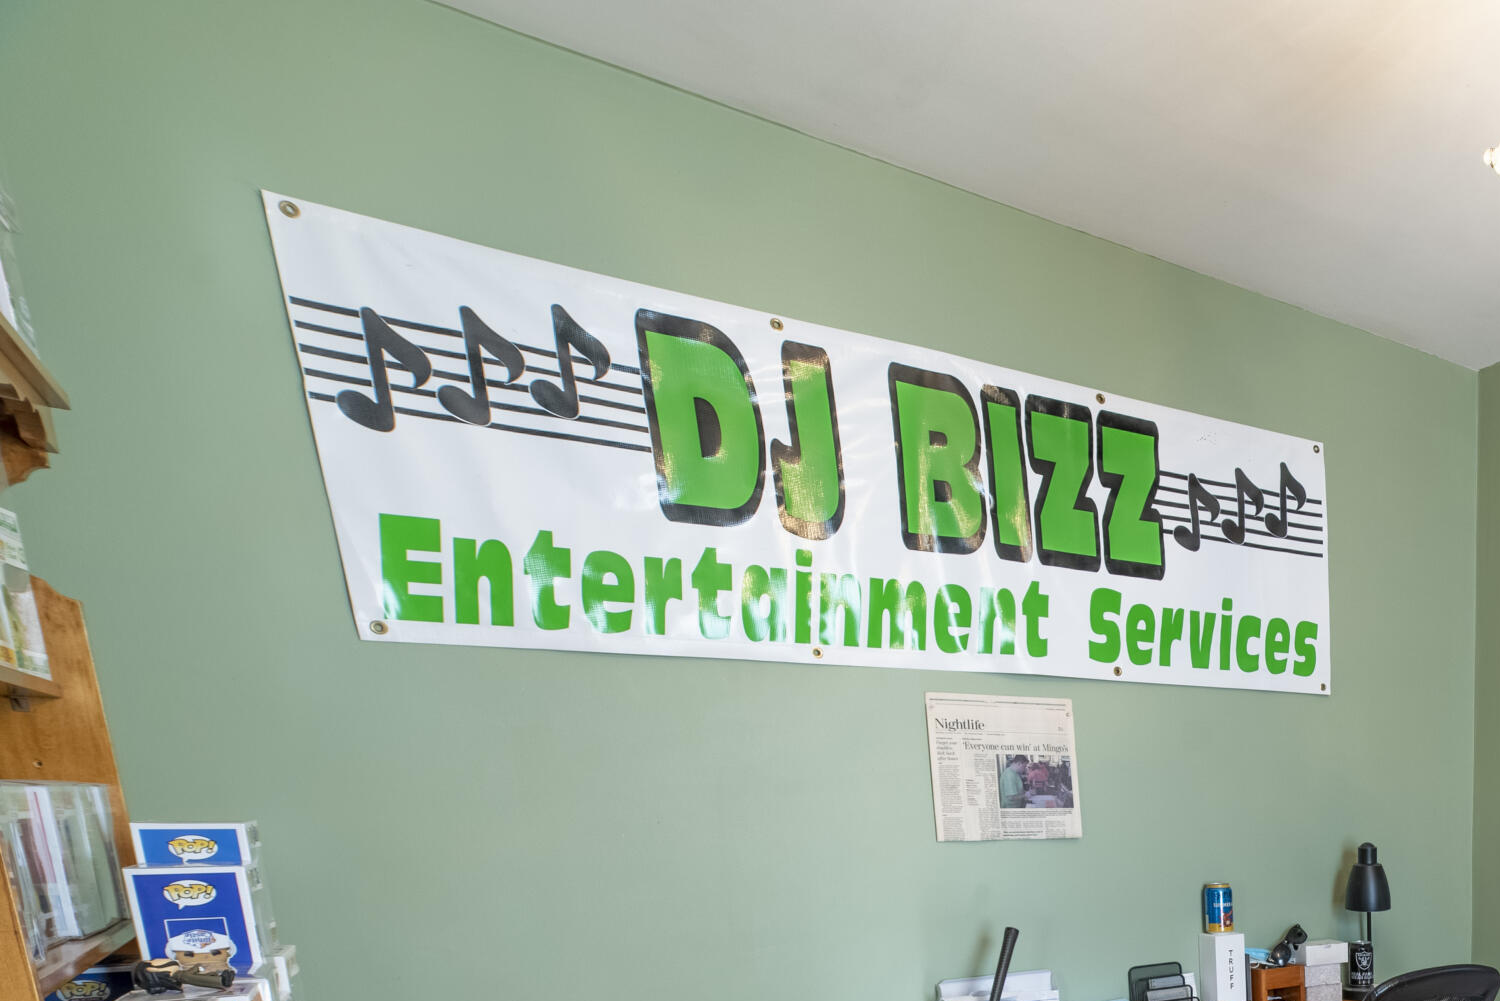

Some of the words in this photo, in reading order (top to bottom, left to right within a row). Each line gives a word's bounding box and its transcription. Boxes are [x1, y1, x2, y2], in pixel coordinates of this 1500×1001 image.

[634, 308, 845, 541] DJ
[888, 361, 1166, 581] BIZZ
[379, 513, 1049, 657] Entertainment
[1088, 587, 1319, 676] Services
[935, 718, 985, 731] Nightlife
[168, 838, 217, 855] POP!
[163, 883, 215, 902] POP!
